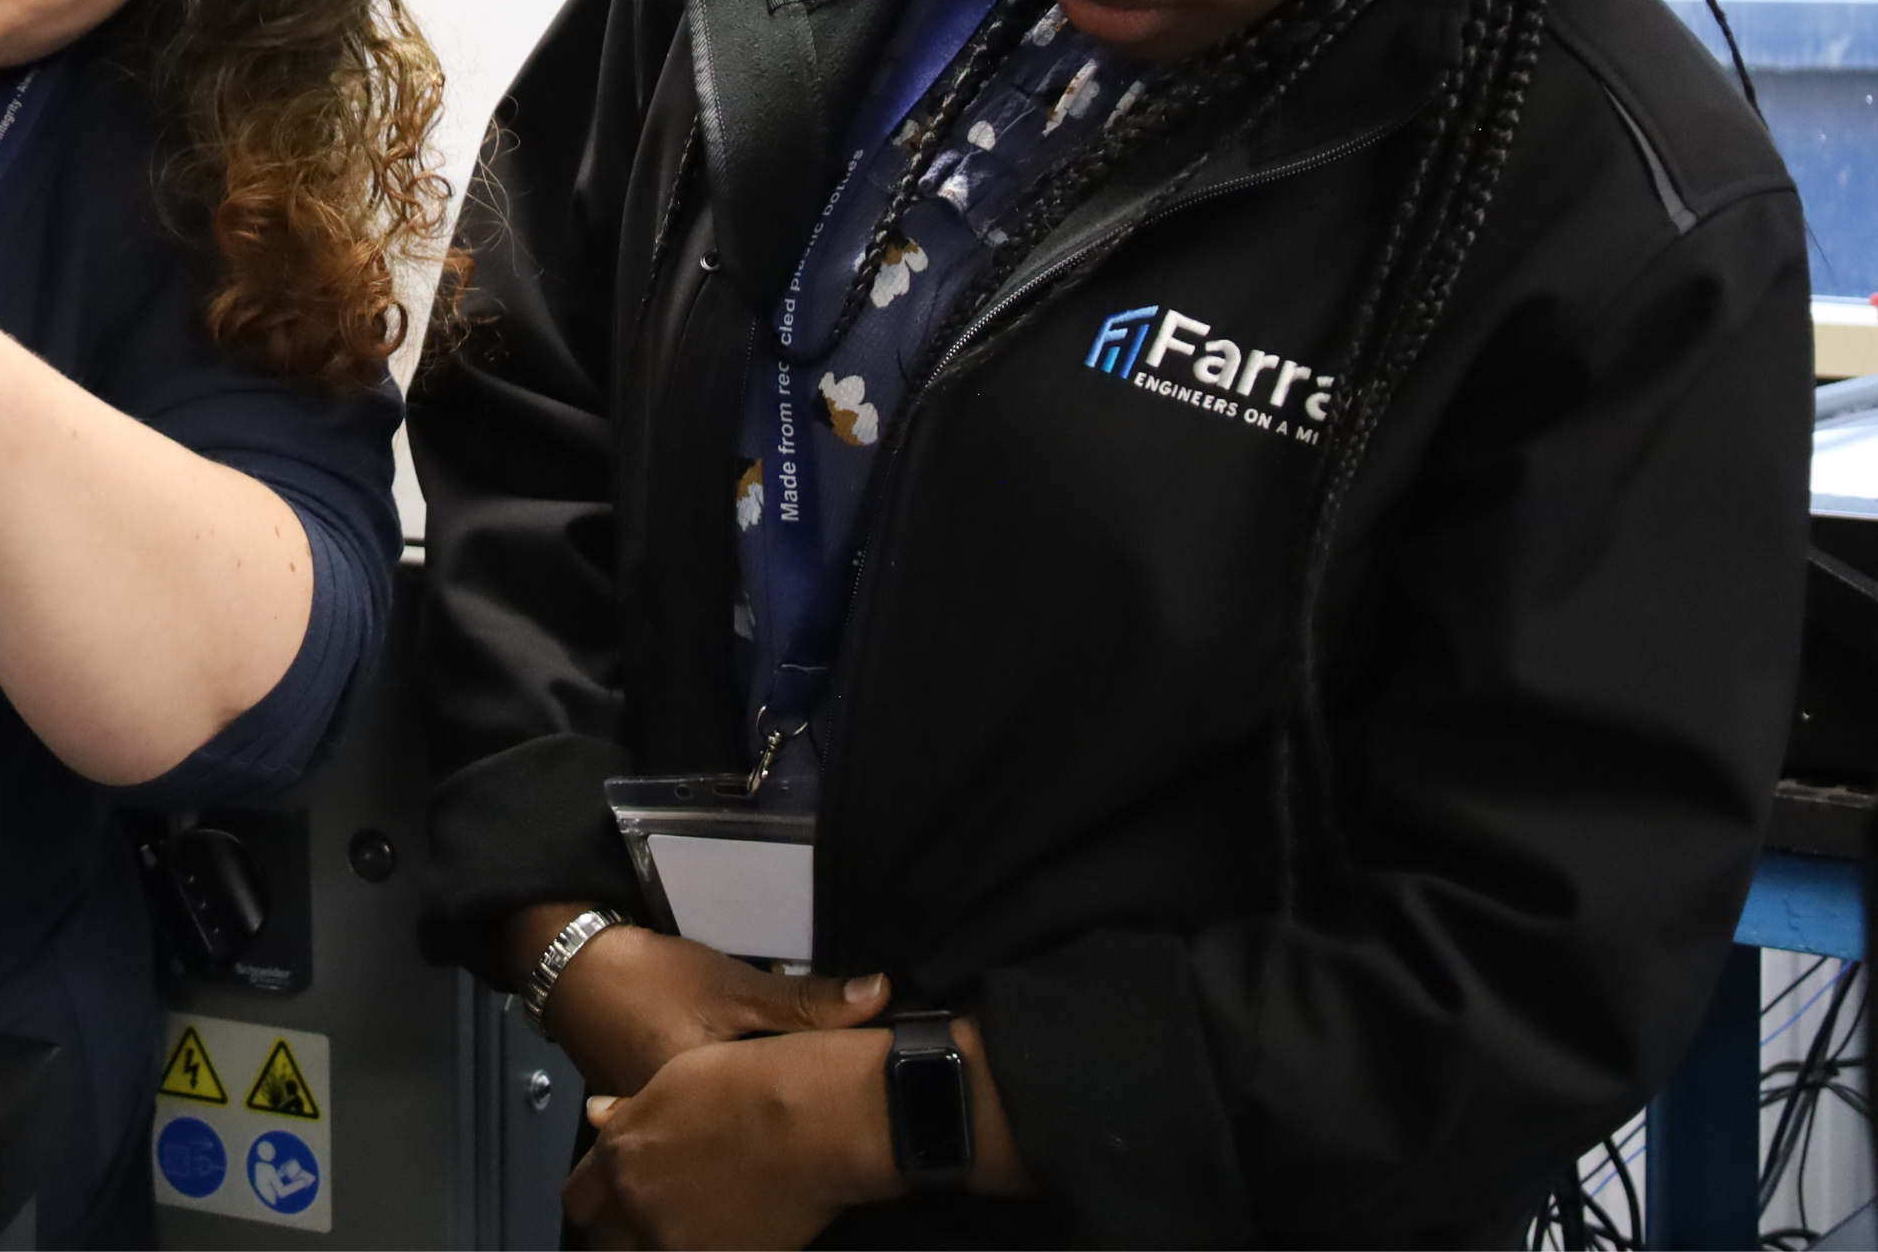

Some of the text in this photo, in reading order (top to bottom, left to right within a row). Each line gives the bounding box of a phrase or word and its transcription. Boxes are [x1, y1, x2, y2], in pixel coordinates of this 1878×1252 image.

[777, 402, 796, 455] from
[1133, 370, 1239, 418] ENGINEERS
[1243, 407, 1273, 430] ON
[1275, 420, 1289, 436] A
[779, 461, 800, 522] Made
[235, 962, 291, 978] Schneider
